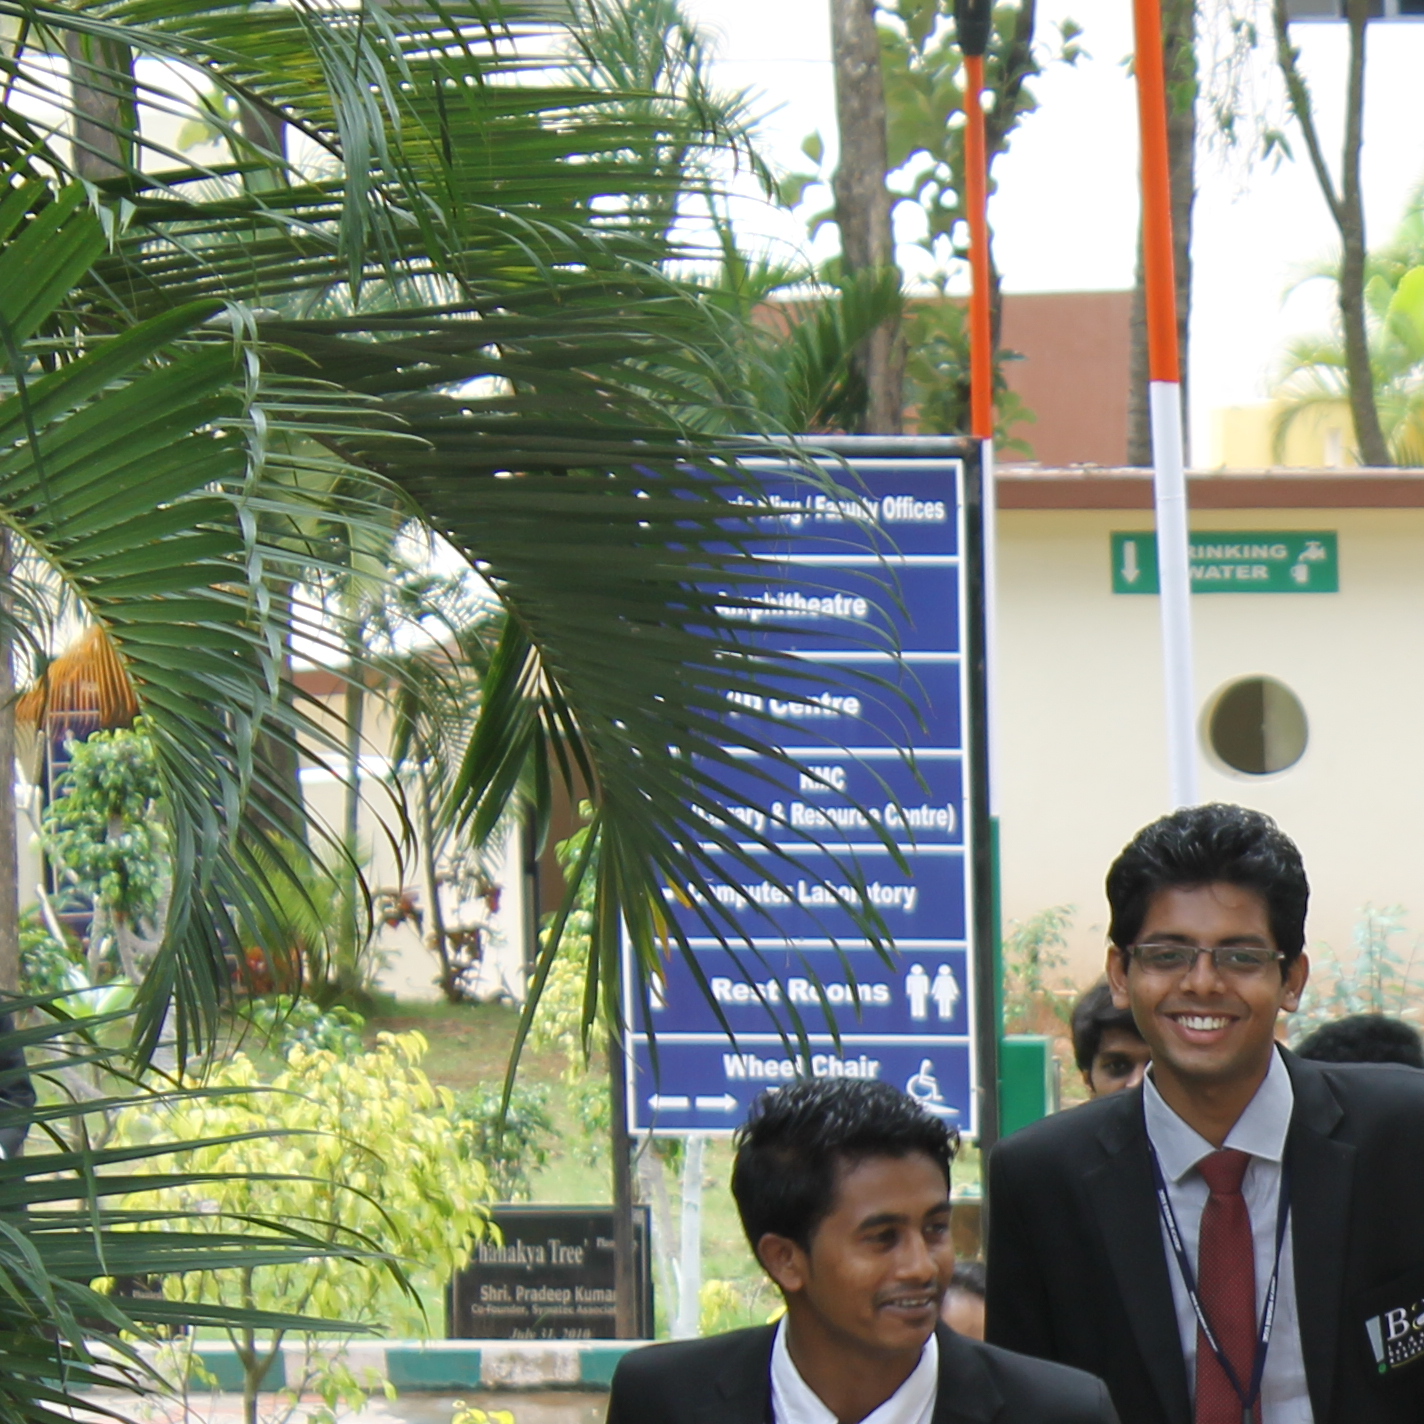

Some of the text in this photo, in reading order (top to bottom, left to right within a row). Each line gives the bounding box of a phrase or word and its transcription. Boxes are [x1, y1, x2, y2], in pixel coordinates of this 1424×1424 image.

[882, 495, 946, 520] Offices
[1188, 544, 1288, 559] RINKING
[790, 802, 881, 826] Resource
[711, 977, 890, 1002] Rest Rooms
[811, 1055, 878, 1079] Chair
[515, 1284, 571, 1305] Pradeep
